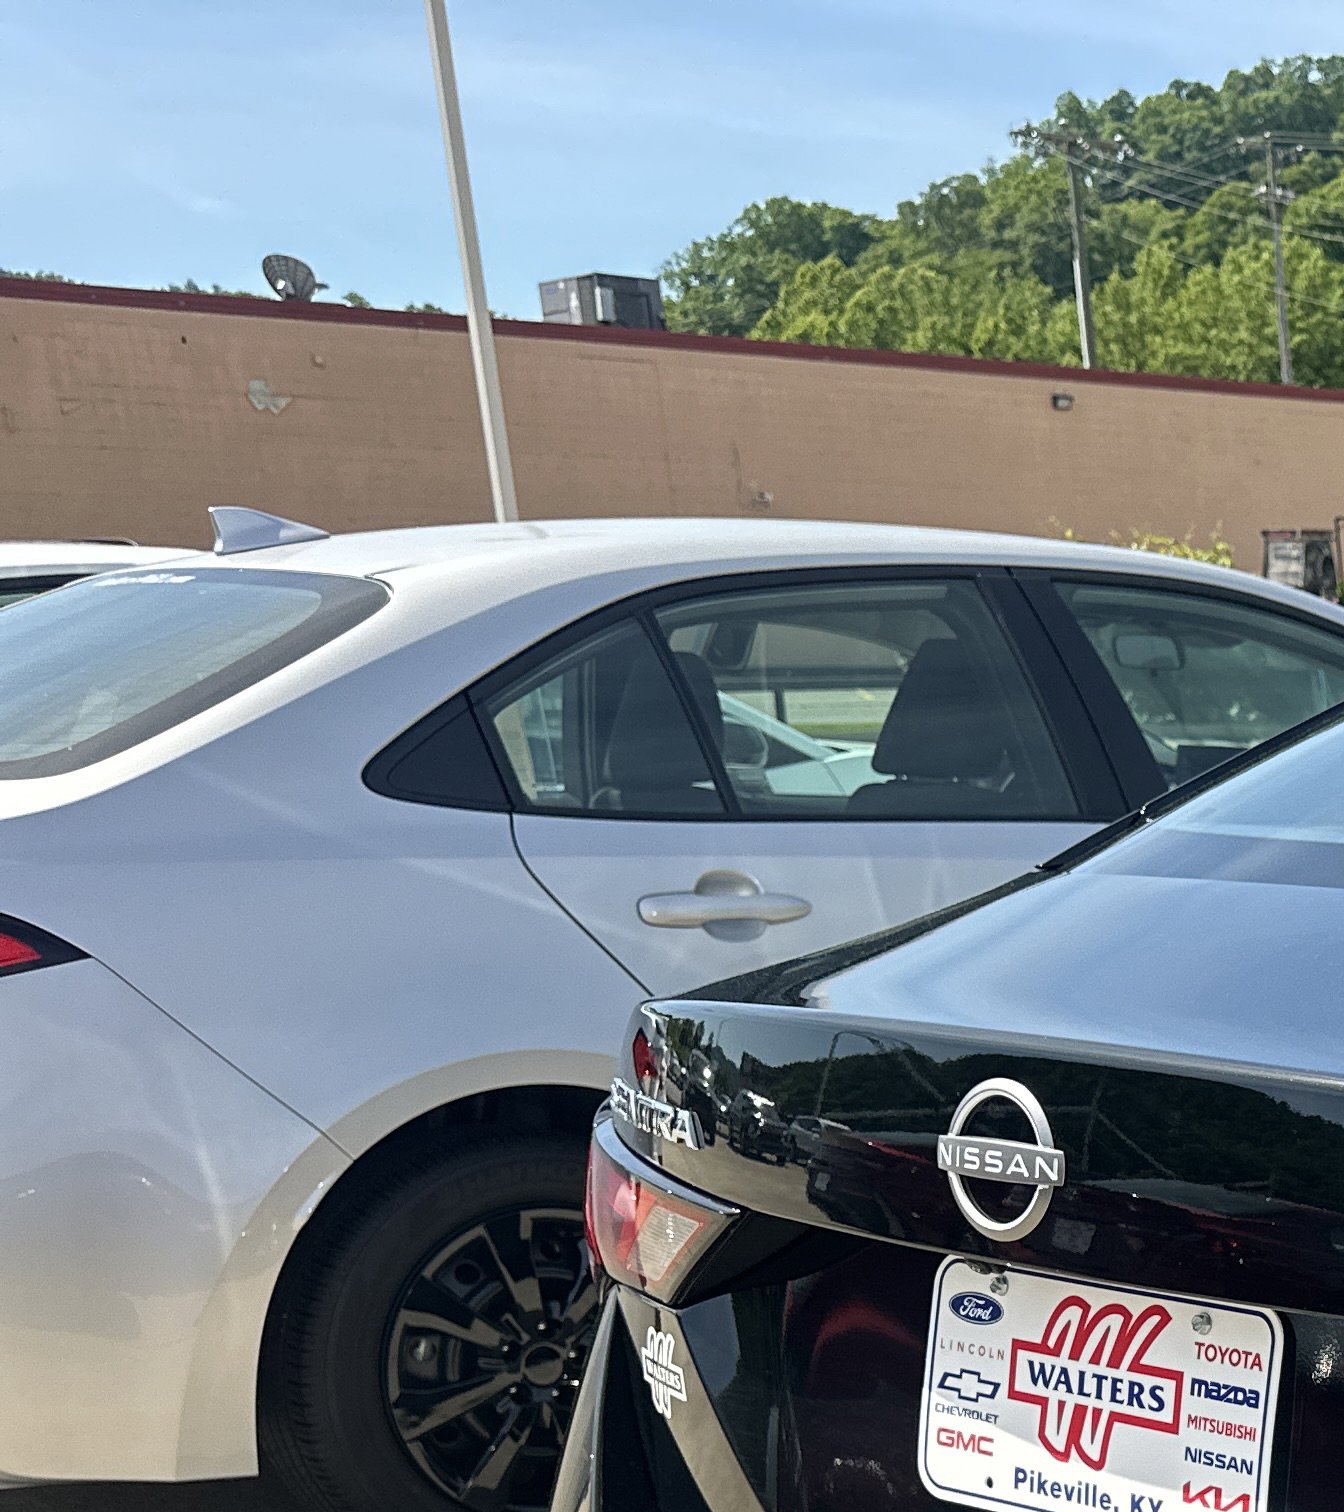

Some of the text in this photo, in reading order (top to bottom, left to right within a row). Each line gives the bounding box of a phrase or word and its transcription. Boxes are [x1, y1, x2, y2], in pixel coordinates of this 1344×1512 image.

[938, 1142, 1059, 1181] NISSAN
[959, 1296, 994, 1320] Ford
[940, 1338, 1005, 1360] LINCOLN
[1194, 1341, 1263, 1371] TOYOTA
[1027, 1359, 1166, 1413] WALTERS
[935, 1402, 999, 1425] CHEVROLET
[1187, 1414, 1257, 1442] MITSUBISHI
[936, 1427, 994, 1457] GMC
[1184, 1446, 1254, 1475] NISSAN
